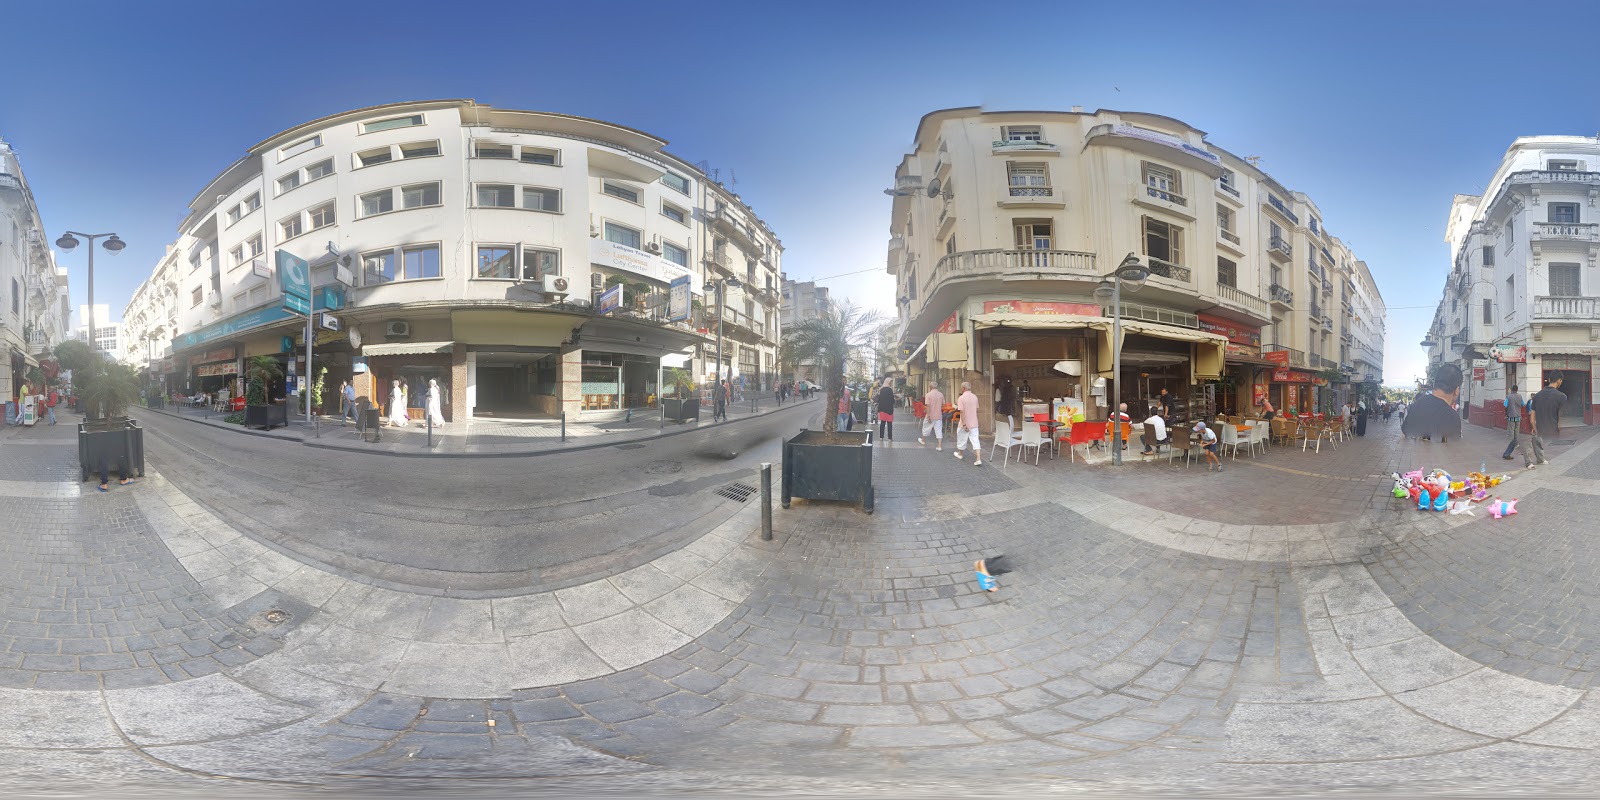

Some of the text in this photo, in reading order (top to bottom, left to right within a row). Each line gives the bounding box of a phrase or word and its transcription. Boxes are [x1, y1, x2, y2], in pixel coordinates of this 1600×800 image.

[613, 252, 648, 267] Lufthansa
[613, 258, 648, 272] City Center
